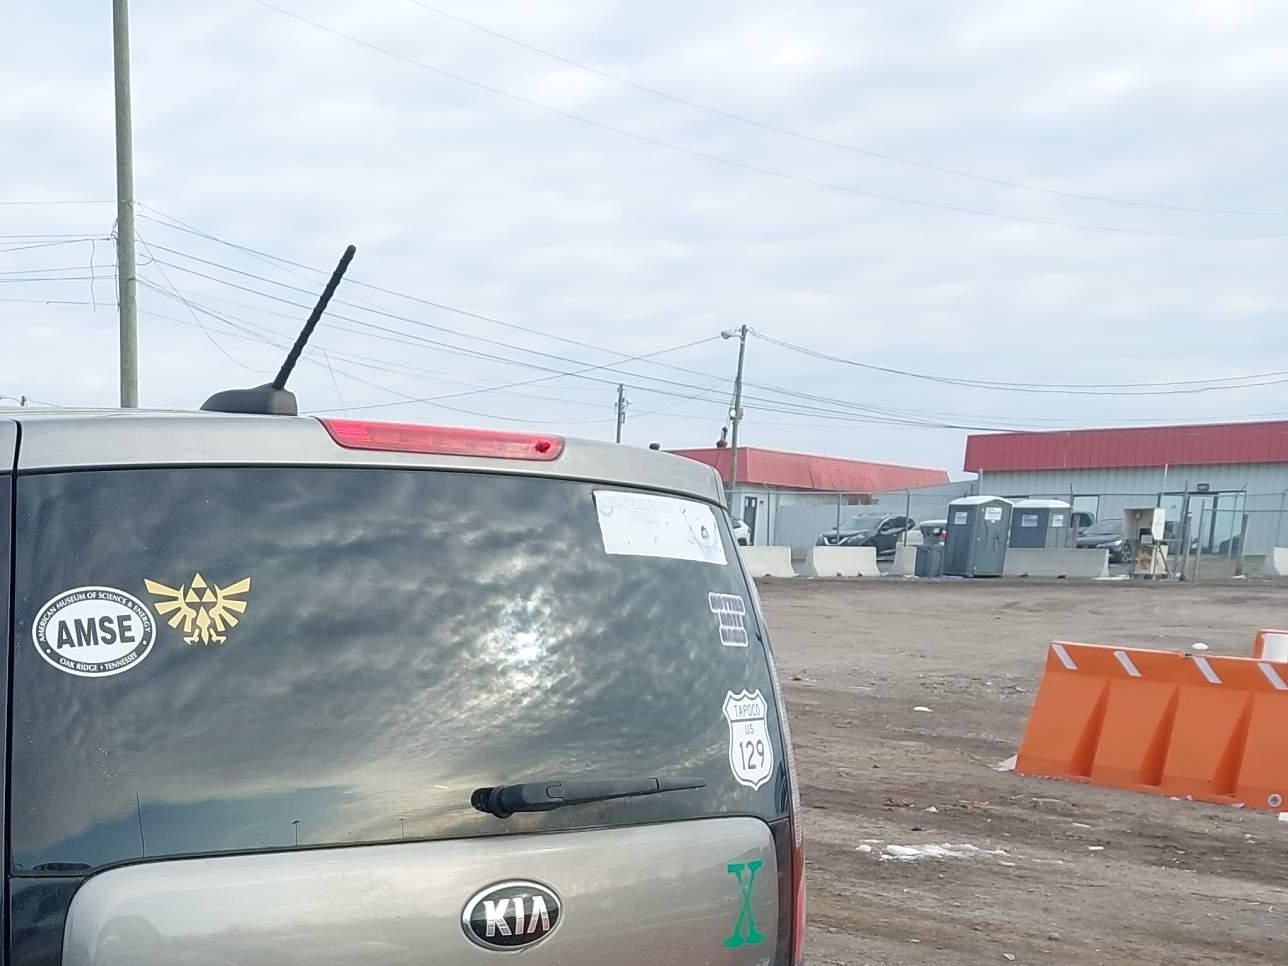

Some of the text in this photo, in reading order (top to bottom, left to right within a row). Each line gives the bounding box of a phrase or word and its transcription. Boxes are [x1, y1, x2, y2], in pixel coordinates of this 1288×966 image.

[37, 606, 57, 642] AMERICAN
[56, 593, 87, 610] MUSEUM
[86, 591, 98, 600] OF
[97, 591, 128, 605] SCIENCE
[133, 605, 152, 633] ENERGY
[56, 613, 136, 650] AMSE
[59, 651, 138, 672] OAK RIDGE TENNESSEE
[733, 703, 761, 718] TAPOCO
[744, 724, 754, 735] US
[739, 739, 765, 771] 129
[482, 895, 550, 938] KIA
